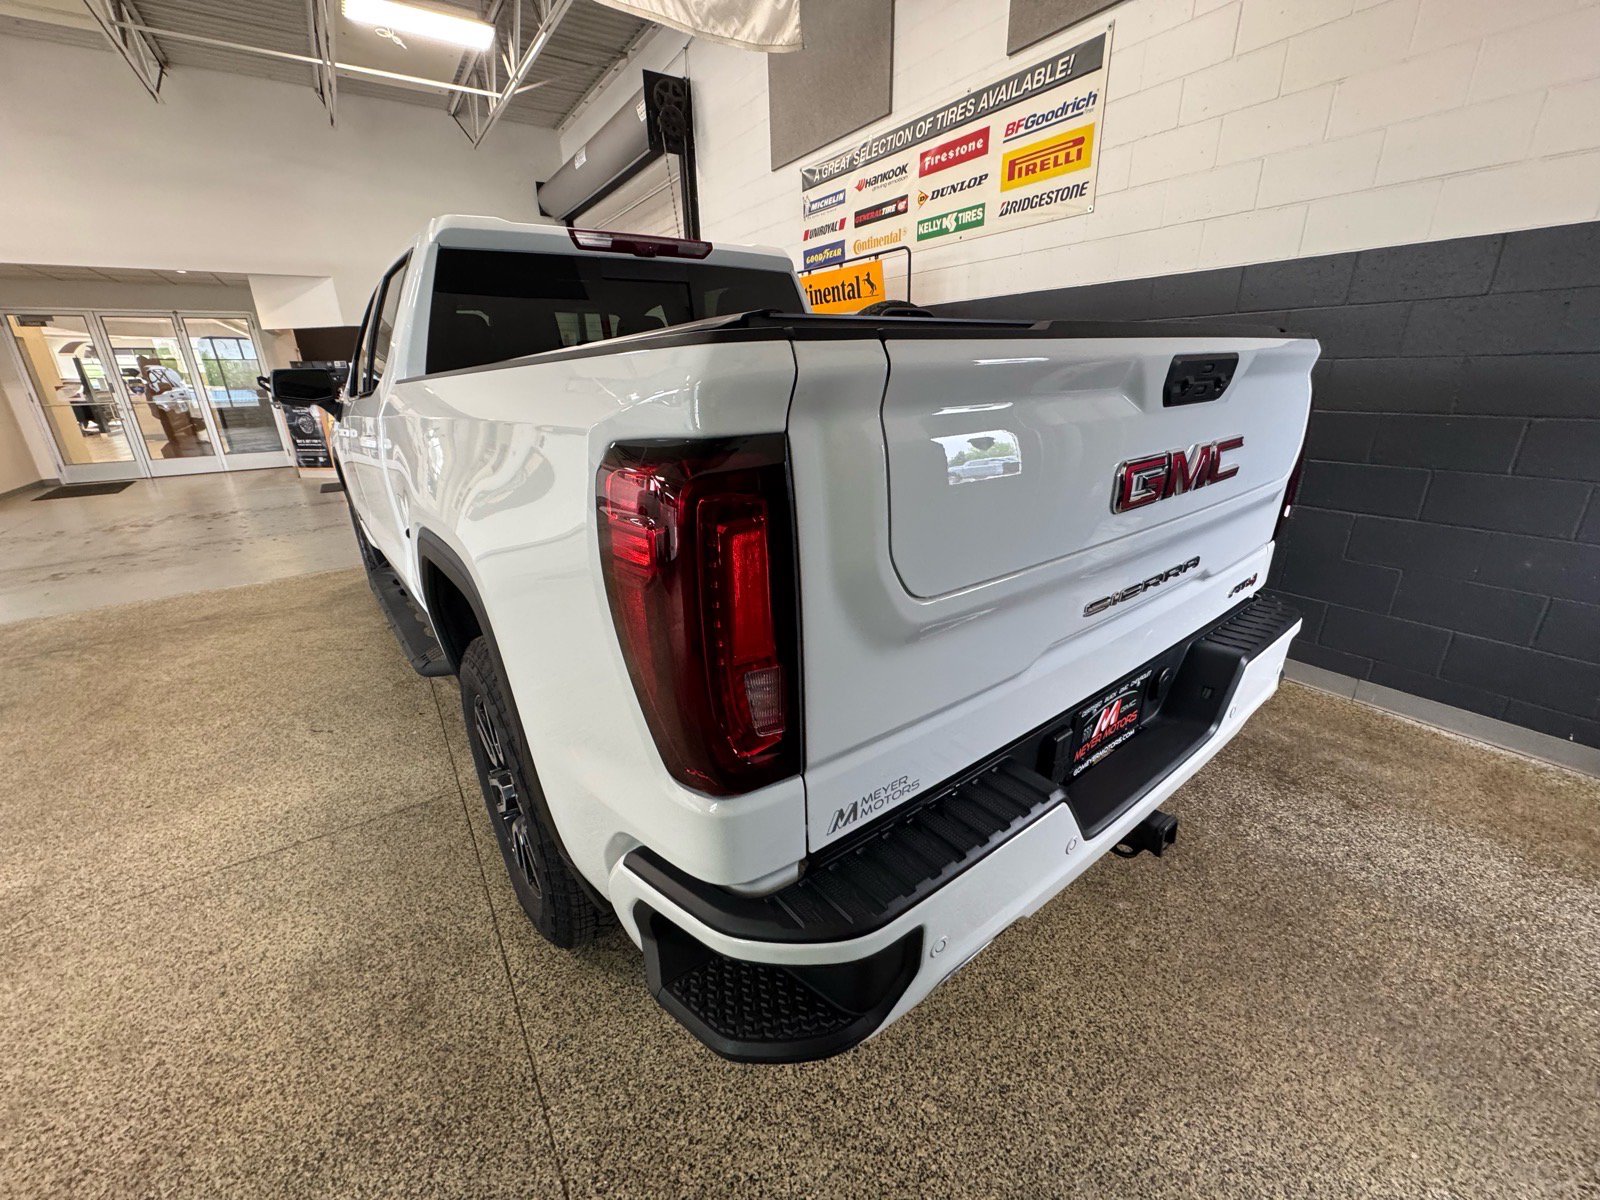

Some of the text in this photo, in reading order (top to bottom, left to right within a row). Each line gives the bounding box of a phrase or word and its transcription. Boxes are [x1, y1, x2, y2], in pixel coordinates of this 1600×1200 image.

[813, 53, 1076, 183] A GREAT SELECTION OF TIRES AVAILABLE!
[1004, 90, 1098, 138] BFGoodrich
[924, 137, 984, 171] Firestone
[1007, 136, 1085, 182] PIRELLI
[811, 191, 845, 212] MICHELIN
[930, 173, 988, 201] DUNLOP
[999, 181, 1089, 218] BRIDGESTONE
[809, 221, 838, 239] UNIROYAL
[918, 218, 941, 235] KELLY
[958, 207, 983, 225] TIRES
[806, 247, 842, 264] GOODYEAR
[853, 228, 902, 255] Continental
[1110, 434, 1244, 515] GMC
[1083, 556, 1201, 617] SIERRA
[1074, 732, 1103, 762] MEYER
[1102, 709, 1138, 740] MOTORS
[860, 775, 908, 807] MEYER
[860, 779, 920, 818] MOTORS
